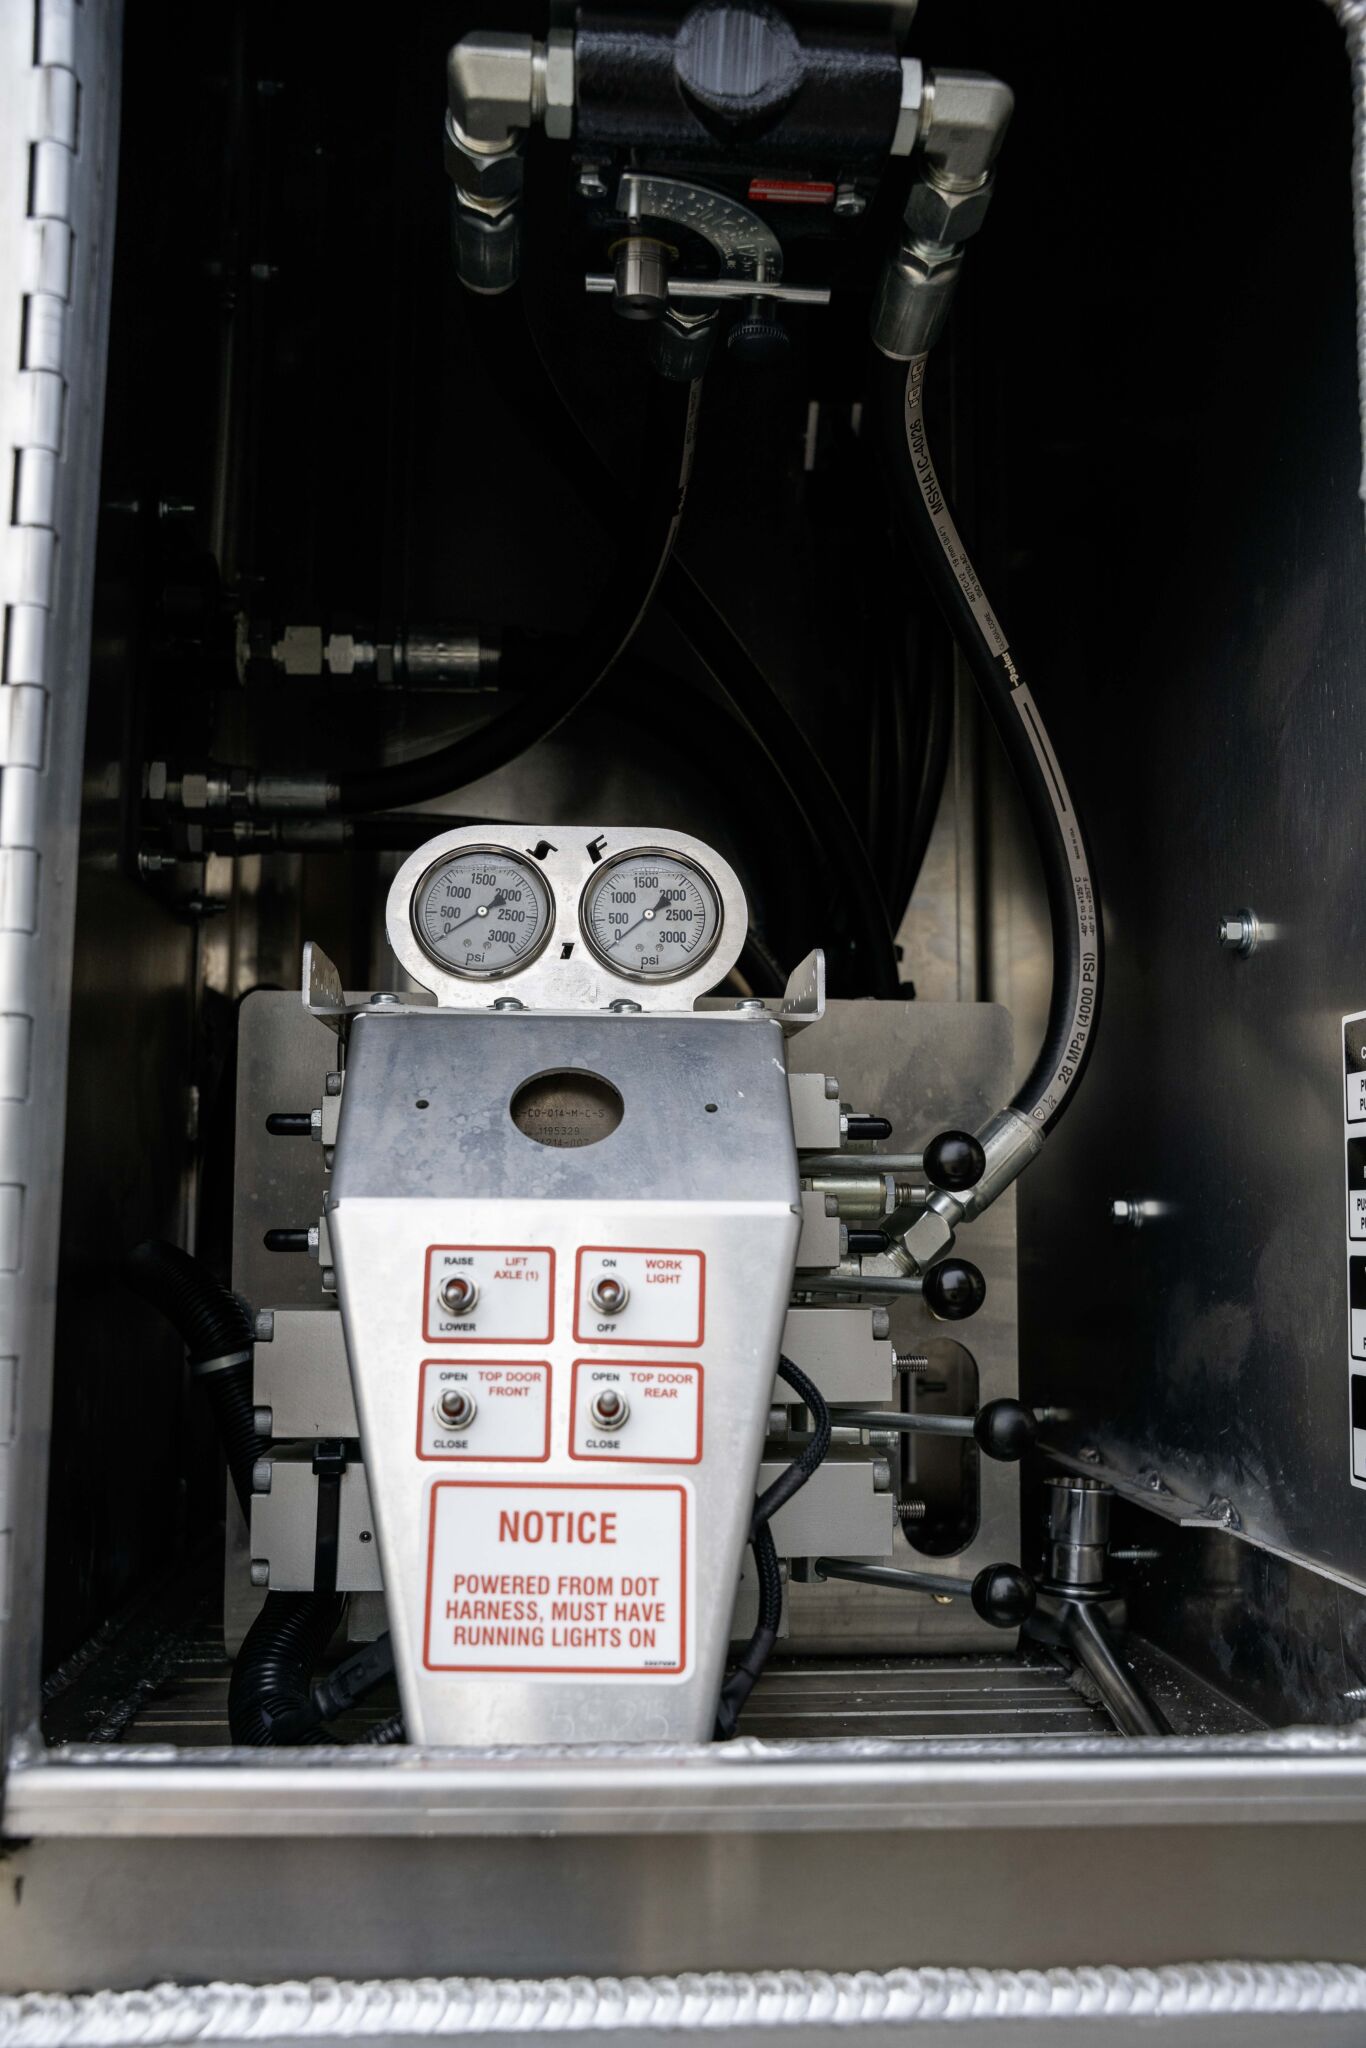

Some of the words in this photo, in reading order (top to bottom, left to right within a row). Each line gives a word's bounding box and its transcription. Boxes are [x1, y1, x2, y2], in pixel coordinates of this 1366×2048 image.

[910, 419, 931, 473] IC-40/26
[922, 471, 944, 515] MSHA
[1001, 652, 1020, 686] Parker
[586, 834, 608, 864] F
[471, 873, 496, 886] 1500
[633, 876, 659, 889] 1500
[446, 886, 471, 900] 1000
[495, 888, 522, 901] 2000
[611, 891, 636, 904] 1000
[659, 889, 686, 901] 2000
[440, 906, 460, 919] 500
[498, 909, 525, 923] 2500
[608, 912, 629, 925] 500
[665, 909, 693, 922] 2500
[444, 922, 451, 934] 0
[487, 930, 515, 944] 3000
[614, 929, 621, 941] 0
[659, 931, 686, 943] 3000
[466, 952, 485, 966] psi
[641, 955, 659, 969] psi
[1083, 952, 1095, 982] PSI)
[1077, 988, 1093, 1027] (4000
[1066, 1032, 1086, 1063] MPa
[1058, 1065, 1073, 1084] 28
[445, 1257, 474, 1266] RAISE
[505, 1257, 528, 1266] LIFT
[602, 1259, 616, 1267] ON
[646, 1260, 682, 1269] WORK
[494, 1270, 522, 1280] AXLE
[526, 1271, 539, 1281] (1)
[646, 1274, 681, 1284] LIGHT
[439, 1323, 476, 1331] LOWER
[598, 1324, 616, 1332] OFF
[440, 1373, 468, 1381] OPEN
[479, 1372, 502, 1381] TOP
[506, 1372, 541, 1382] DOOR
[592, 1373, 620, 1381] OPEN
[630, 1373, 655, 1383] TOP
[658, 1374, 693, 1384] DOOR
[489, 1387, 530, 1396] FRONT
[645, 1388, 678, 1398] REAR
[433, 1441, 468, 1449] CLOSE
[586, 1440, 620, 1449] CLOSE
[499, 1511, 617, 1544] NOTICE
[454, 1575, 550, 1595] POWERED
[558, 1576, 613, 1596] FROM
[622, 1577, 660, 1596] DOT
[446, 1601, 544, 1623] HARNESS,
[552, 1603, 607, 1621] MUST
[615, 1603, 665, 1622] HAVE
[454, 1626, 543, 1646] RUNNING
[552, 1628, 621, 1648] LIGHTS
[630, 1629, 655, 1647] ON
